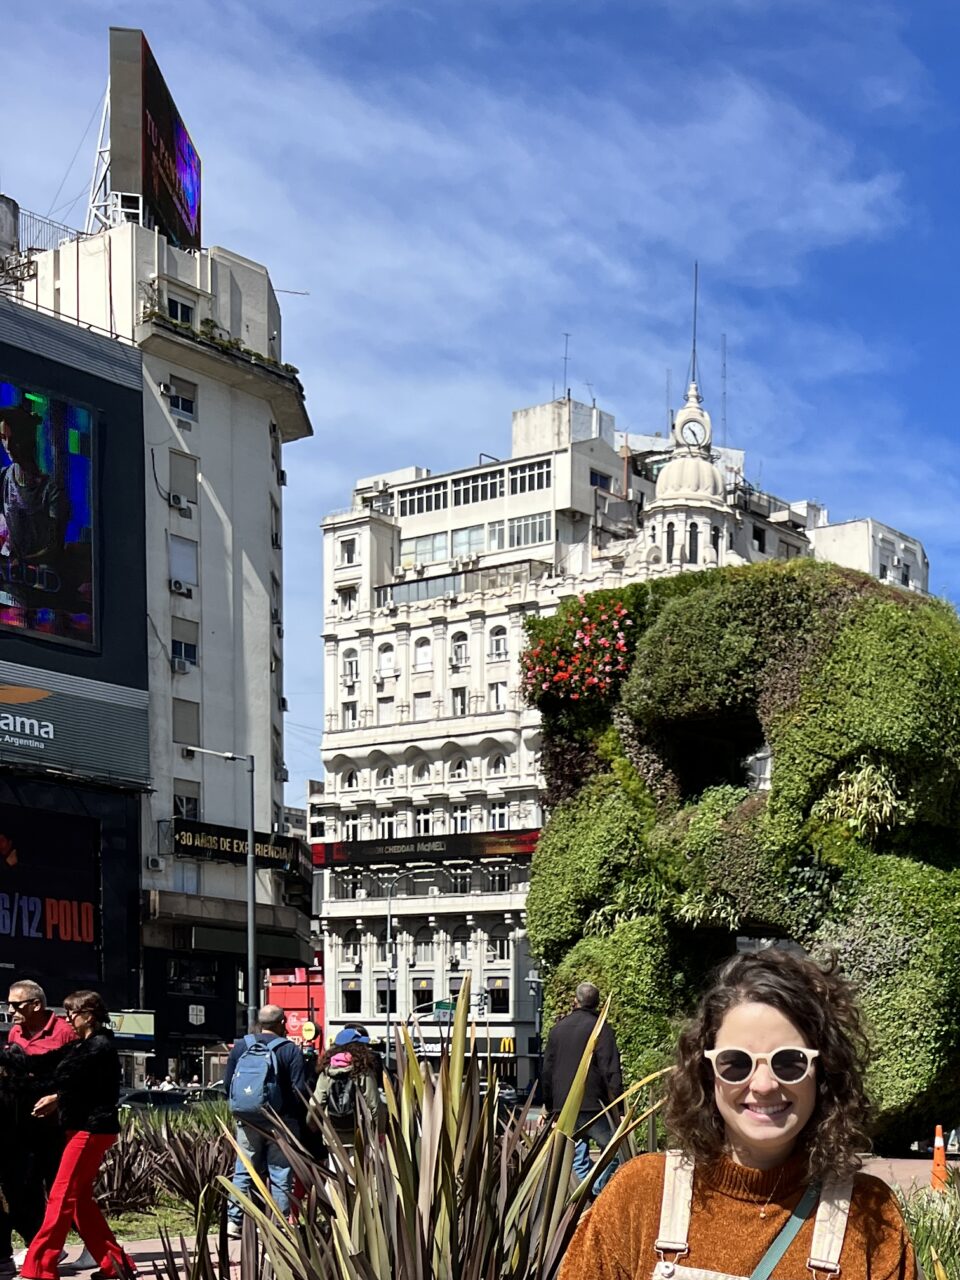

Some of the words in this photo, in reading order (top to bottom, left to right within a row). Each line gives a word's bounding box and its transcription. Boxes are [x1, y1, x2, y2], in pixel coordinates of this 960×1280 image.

[4, 735, 45, 749] Argentina
[219, 837, 231, 852] DE
[233, 839, 288, 861] EXPRIENCIA
[45, 898, 94, 943] POLO
